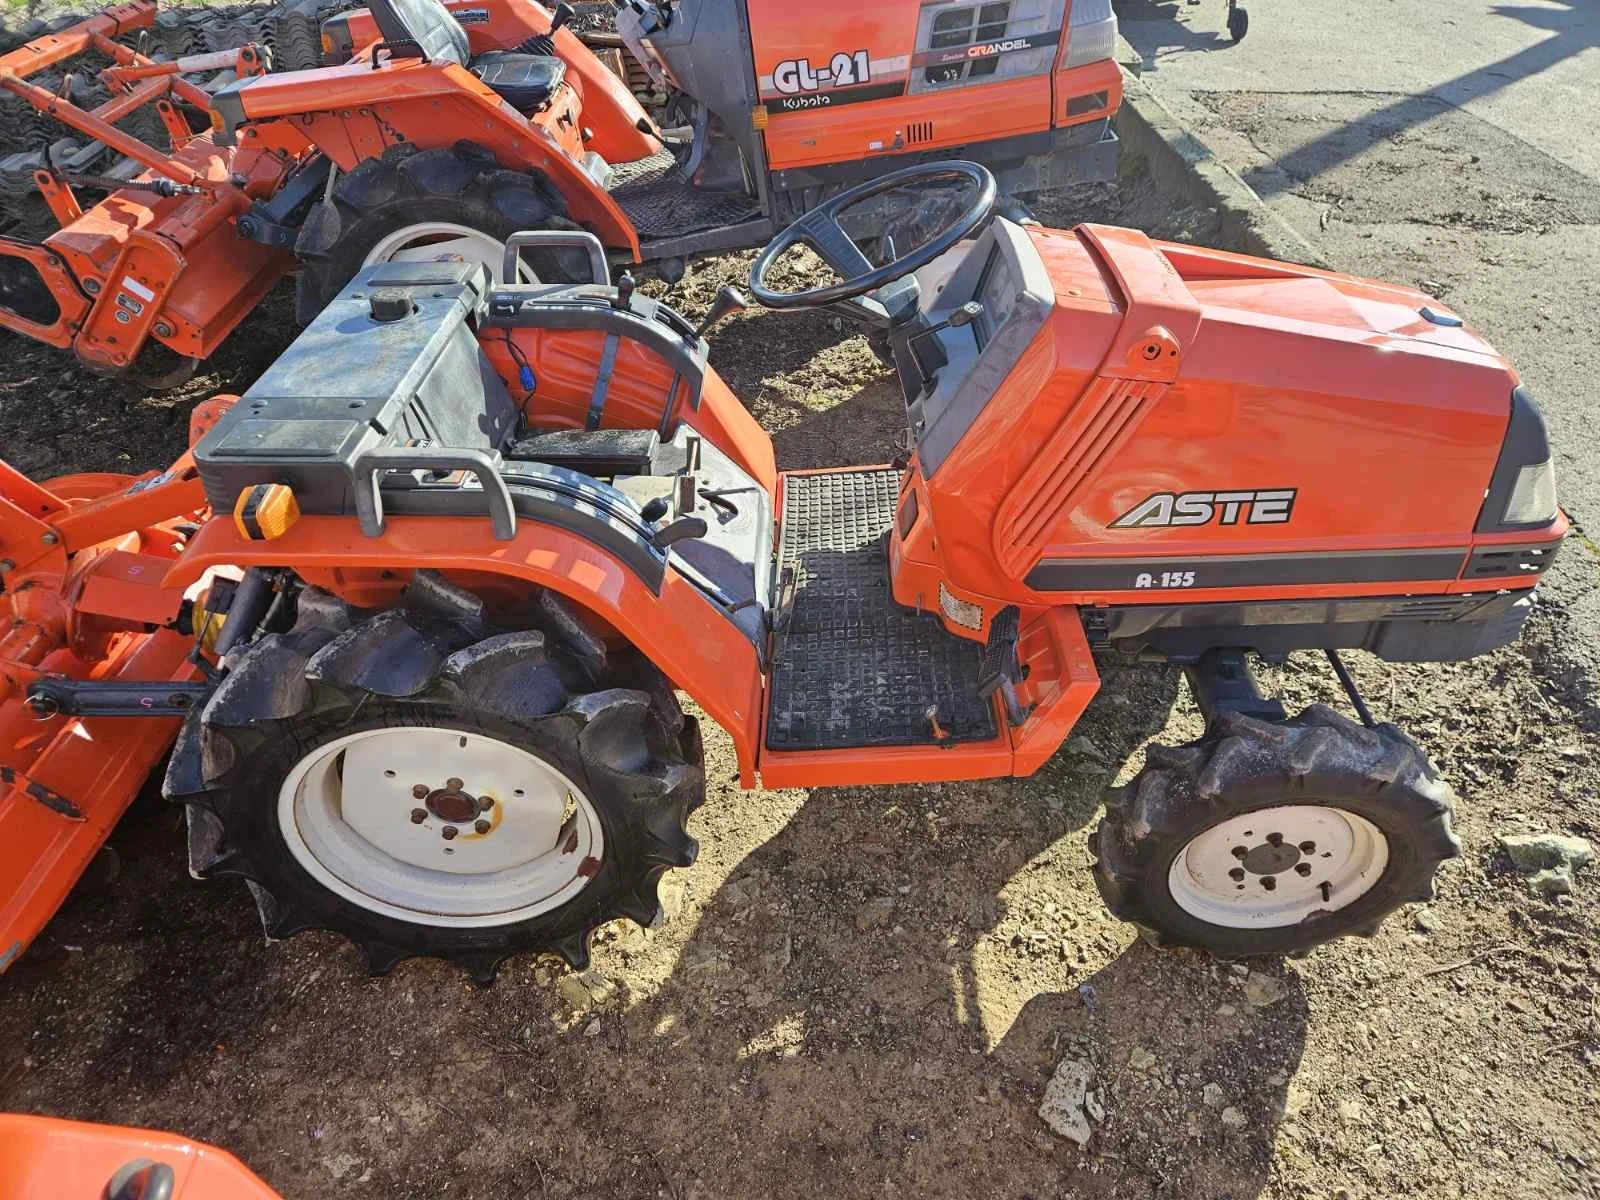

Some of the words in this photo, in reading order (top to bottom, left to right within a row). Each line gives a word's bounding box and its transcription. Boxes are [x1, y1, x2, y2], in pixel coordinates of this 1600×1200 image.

[967, 38, 1031, 58] GRANDEL
[773, 49, 871, 95] GL-21
[782, 94, 831, 109] Kubota
[1106, 487, 1298, 528] ASTE
[1135, 571, 1195, 588] A-155
